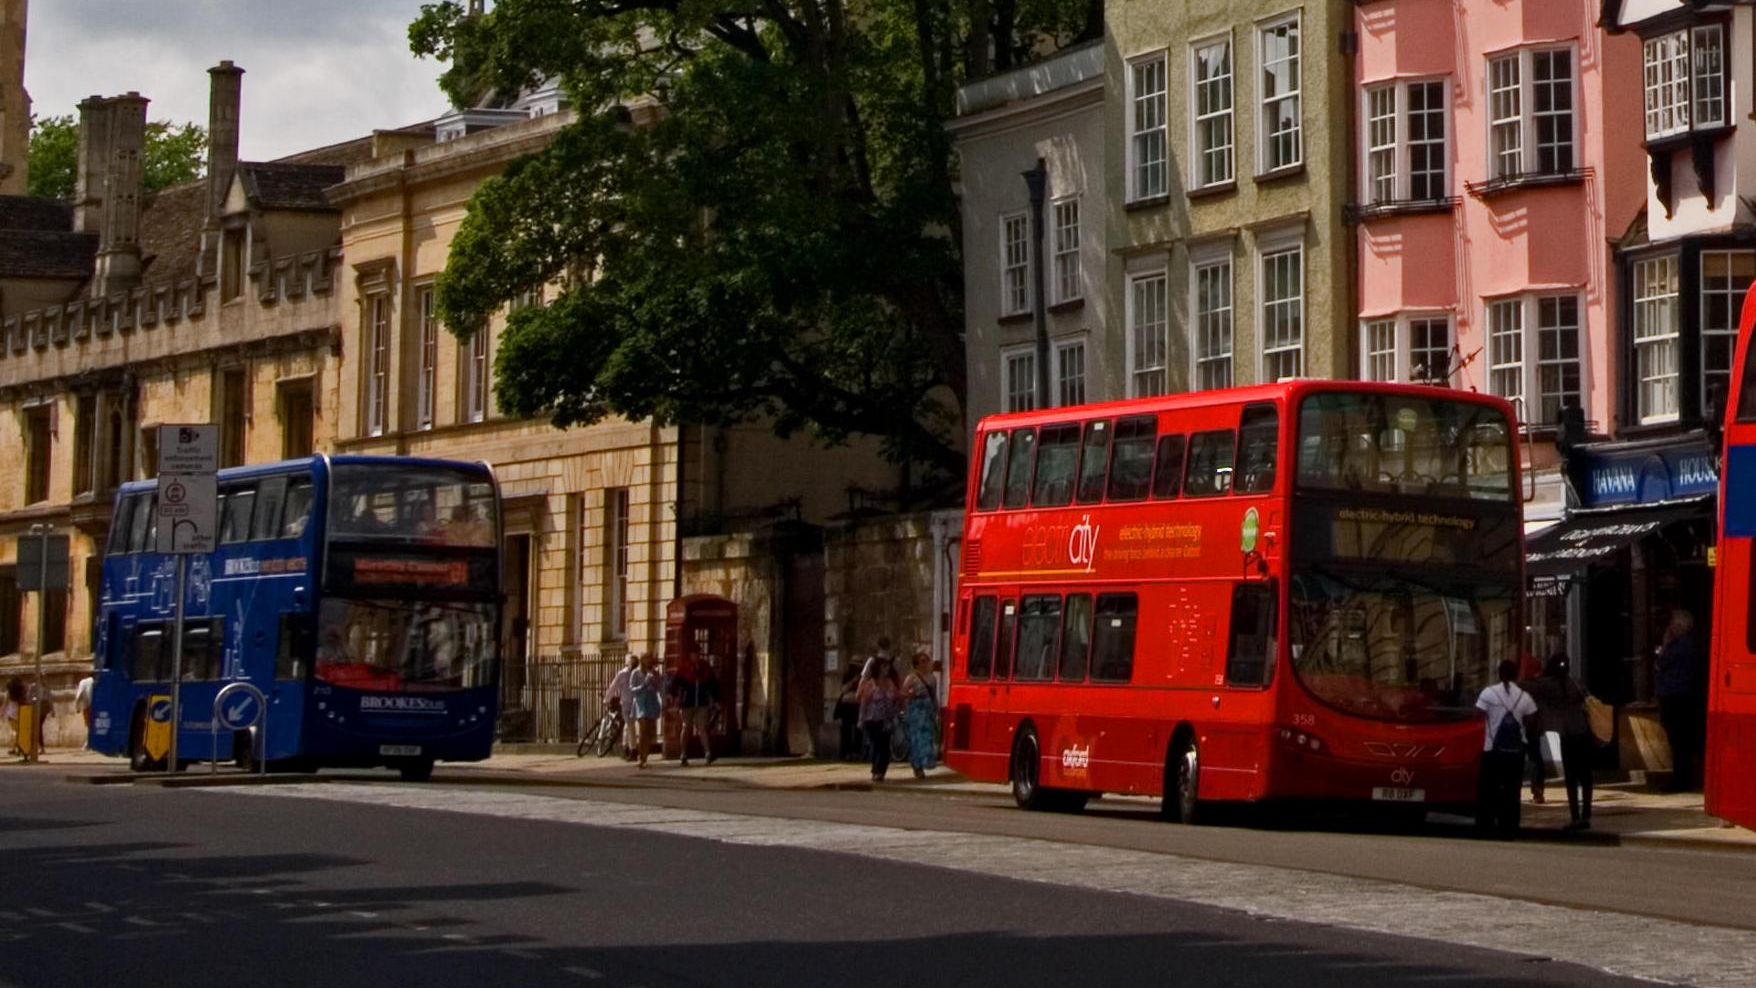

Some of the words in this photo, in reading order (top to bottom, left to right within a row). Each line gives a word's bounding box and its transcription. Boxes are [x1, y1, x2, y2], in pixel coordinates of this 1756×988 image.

[1592, 467, 1636, 495] HAVANA
[1292, 713, 1316, 726] 358
[1390, 767, 1416, 786] city
